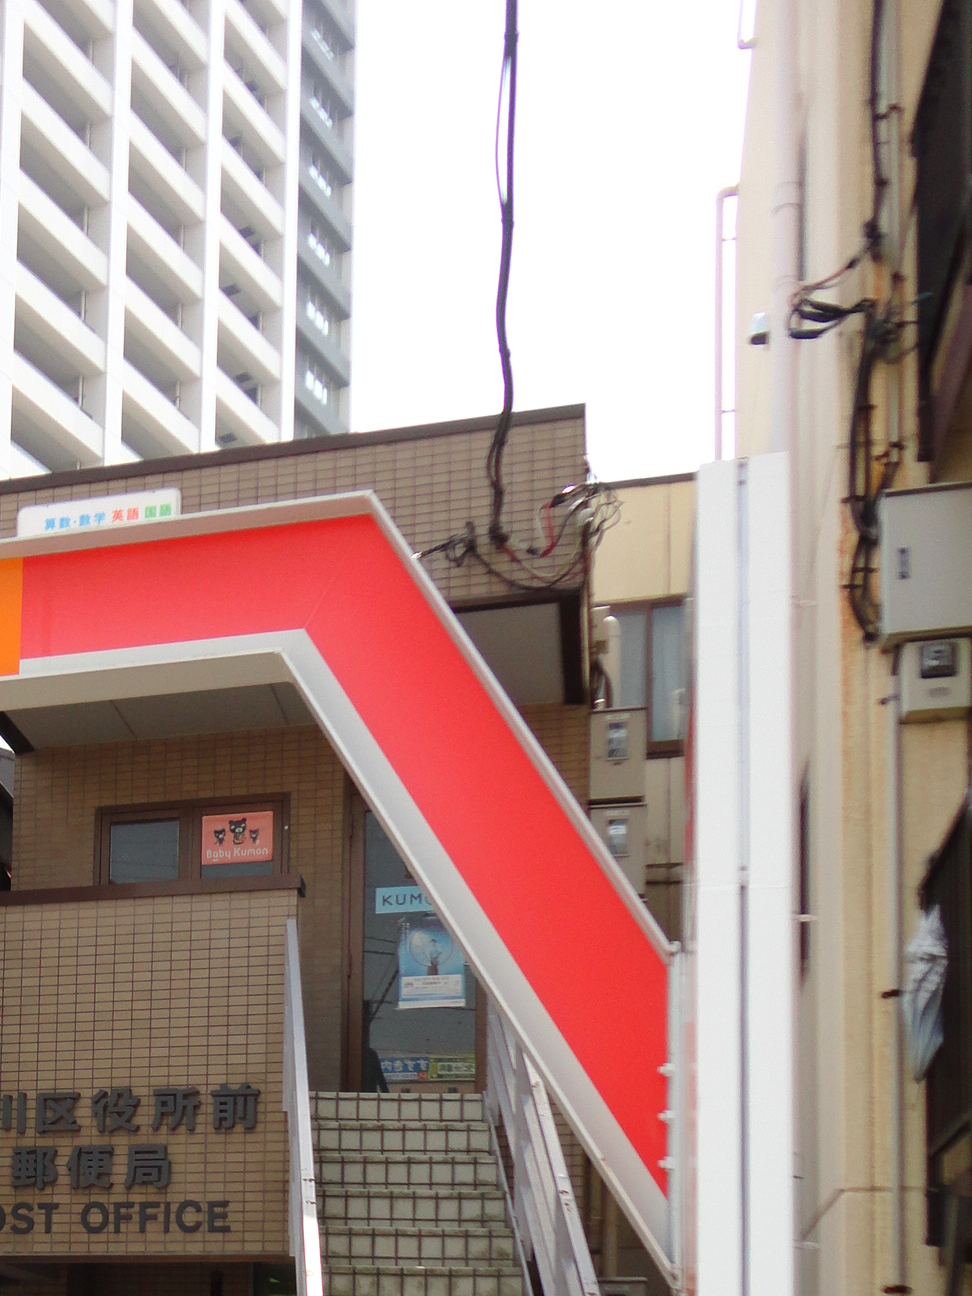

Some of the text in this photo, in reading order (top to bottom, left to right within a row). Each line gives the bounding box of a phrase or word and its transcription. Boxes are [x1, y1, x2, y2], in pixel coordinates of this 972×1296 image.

[112, 506, 139, 523] 英語
[206, 847, 269, 862] Baby Kumon
[10, 1143, 173, 1192] 郵便局
[80, 1200, 231, 1234] OFFICE
